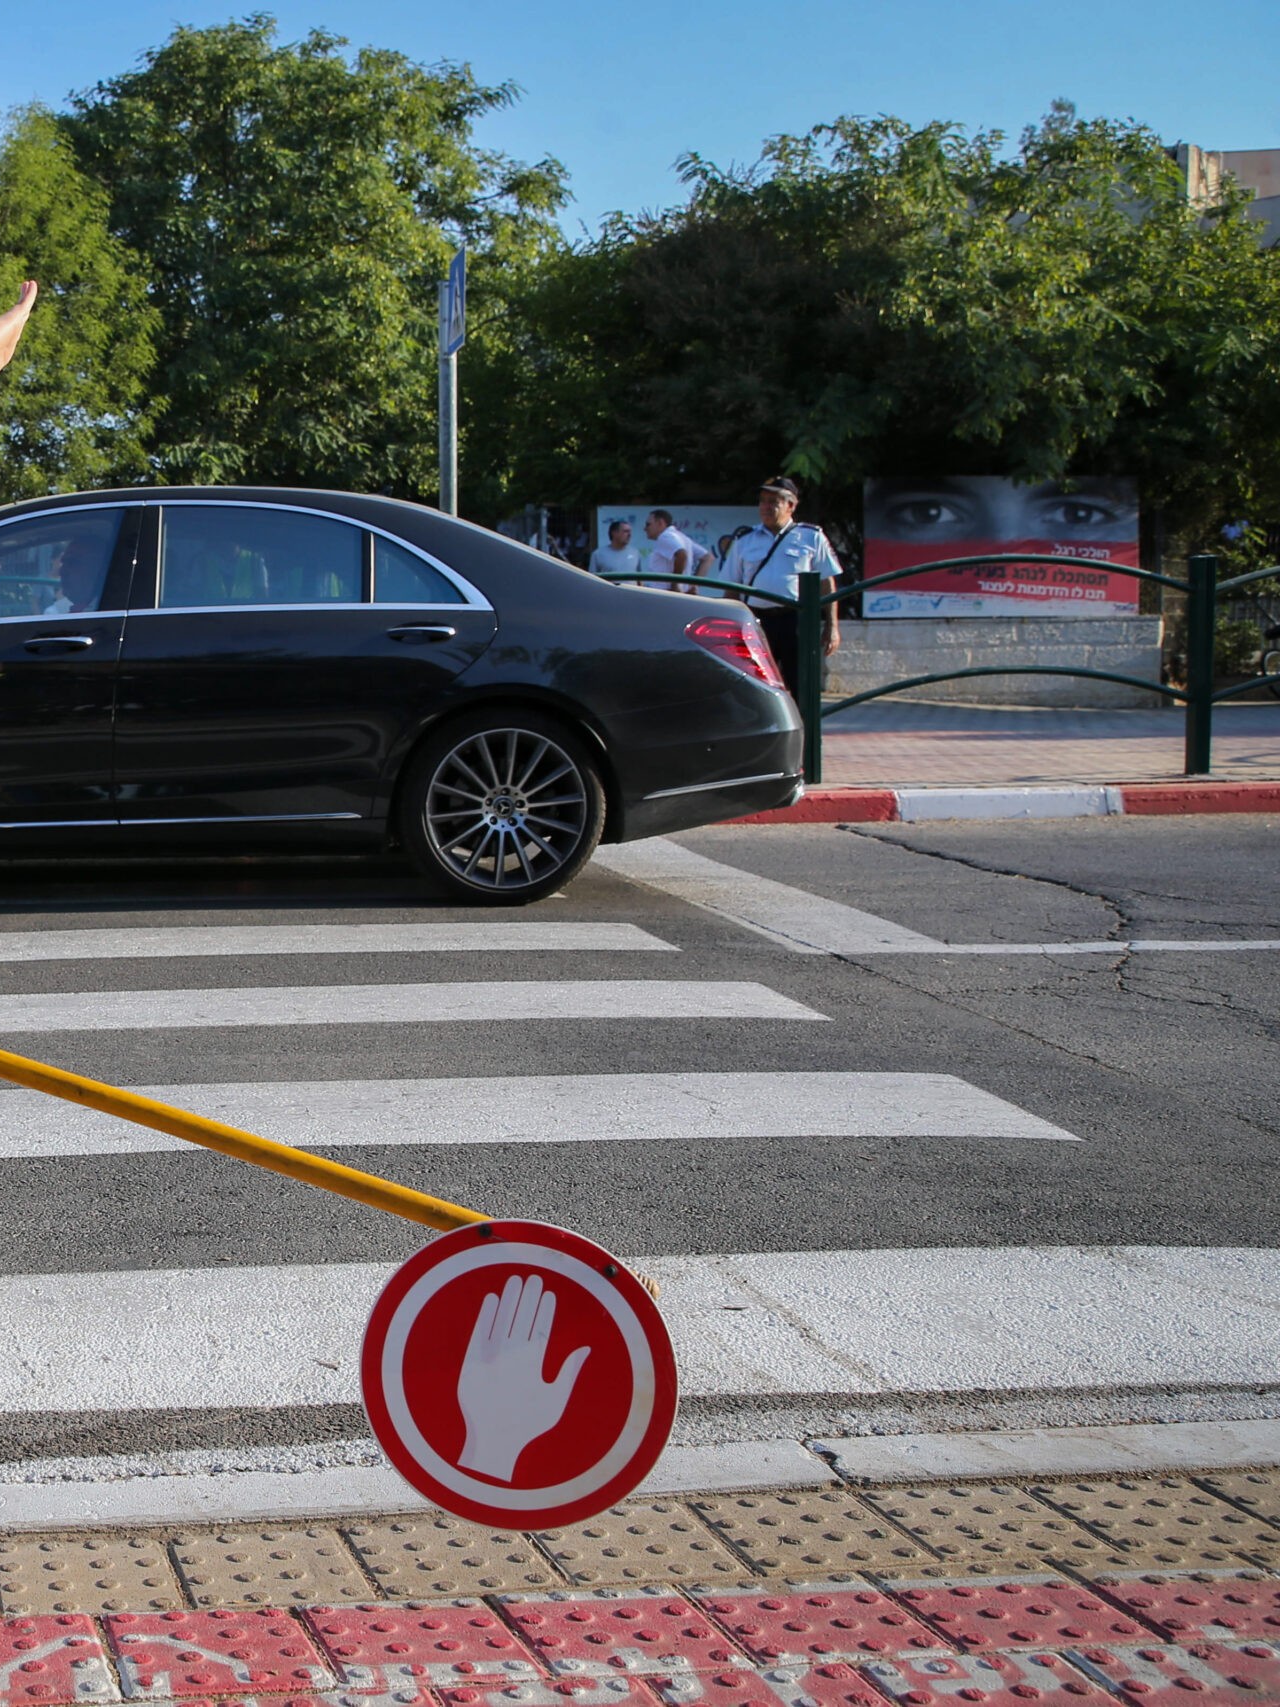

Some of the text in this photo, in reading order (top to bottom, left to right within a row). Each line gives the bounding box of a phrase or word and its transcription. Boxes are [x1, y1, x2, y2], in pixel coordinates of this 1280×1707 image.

[1078, 545, 1111, 560] הולכי
[1013, 566, 1047, 581] לנהג
[1053, 569, 1109, 586] תסתכלו
[1071, 586, 1084, 598] לו
